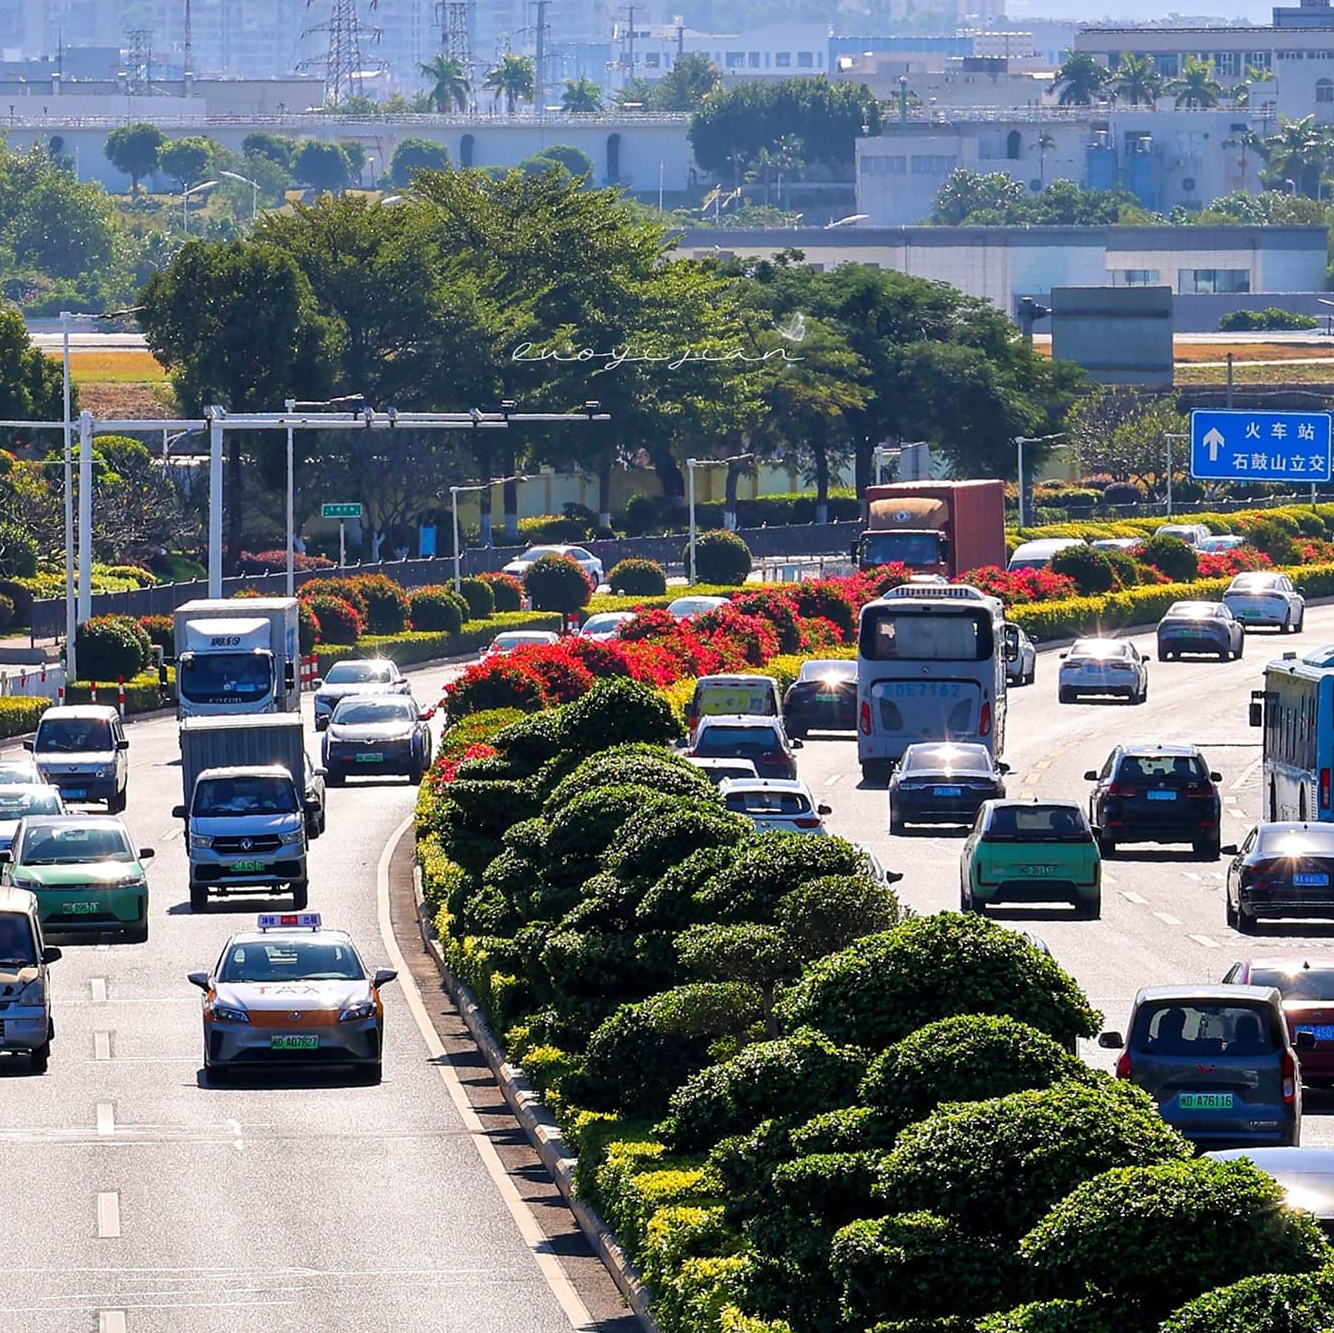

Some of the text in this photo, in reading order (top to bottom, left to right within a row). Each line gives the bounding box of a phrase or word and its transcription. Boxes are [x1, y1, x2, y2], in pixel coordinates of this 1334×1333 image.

[1244, 421, 1316, 441] 火车站
[1232, 452, 1326, 473] 石鼓山立交
